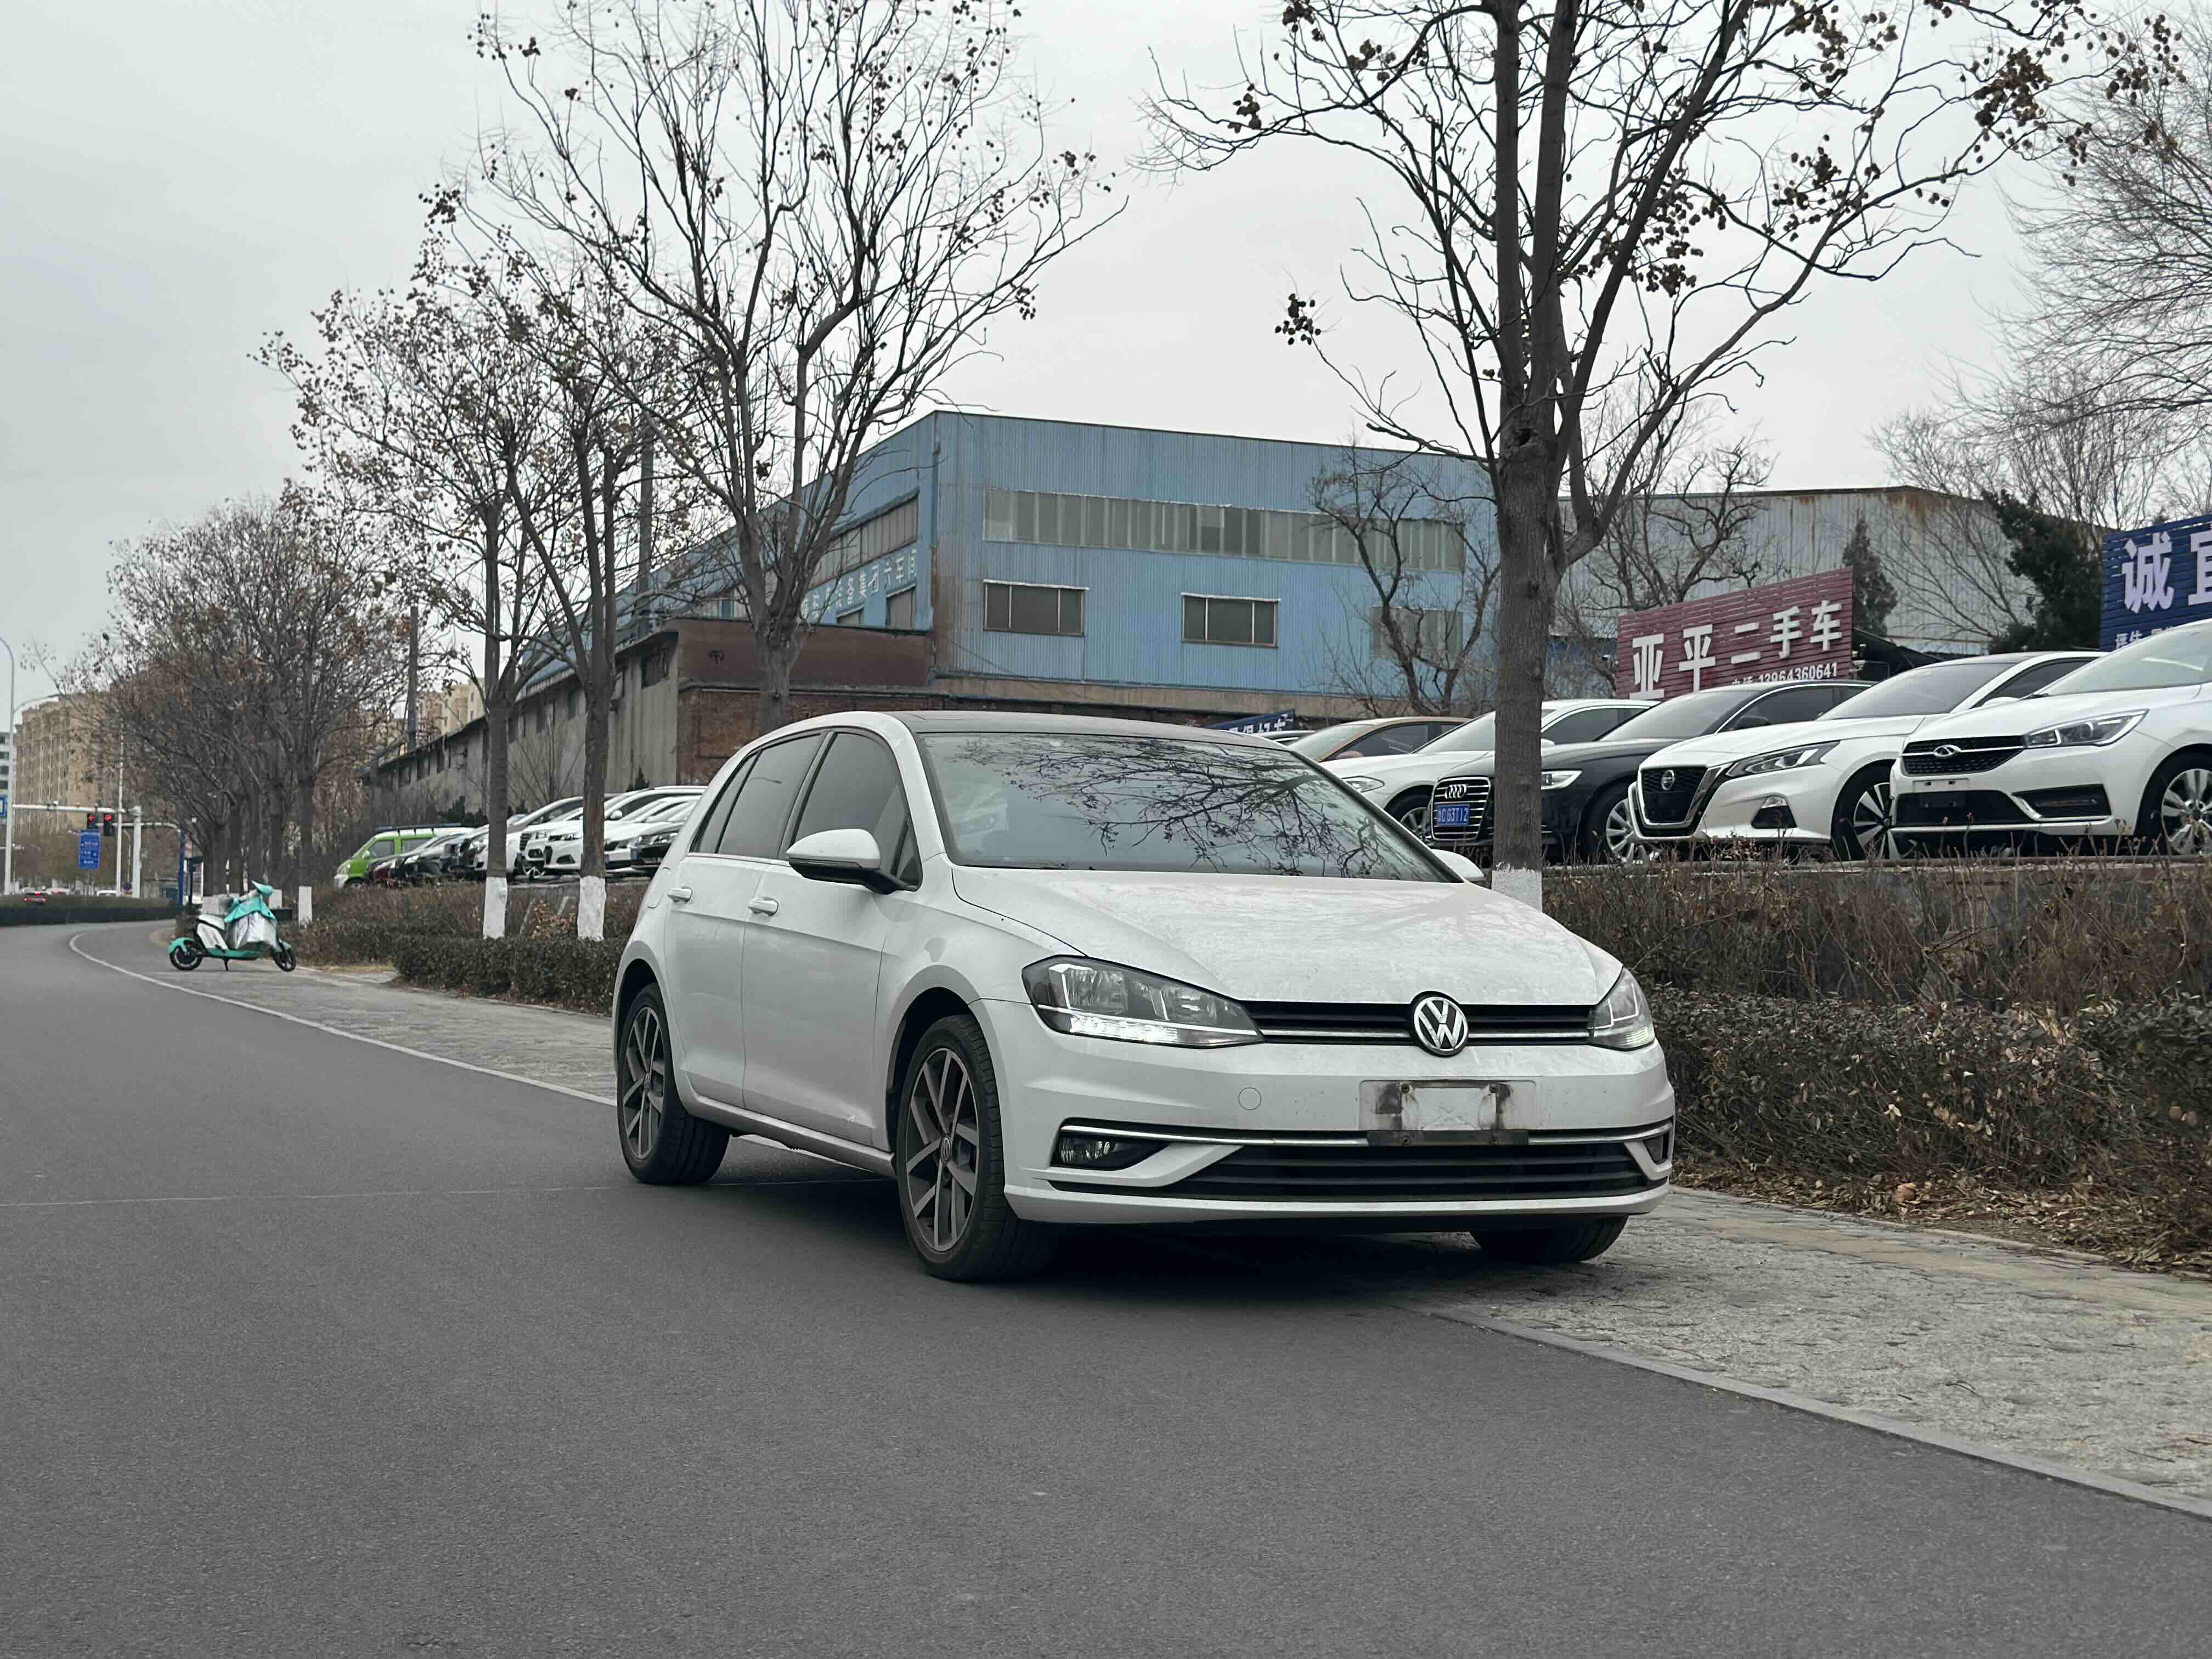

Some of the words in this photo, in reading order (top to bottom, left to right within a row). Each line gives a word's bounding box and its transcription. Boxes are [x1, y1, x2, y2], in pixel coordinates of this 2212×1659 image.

[1629, 600, 1842, 700] 亚平二手车
